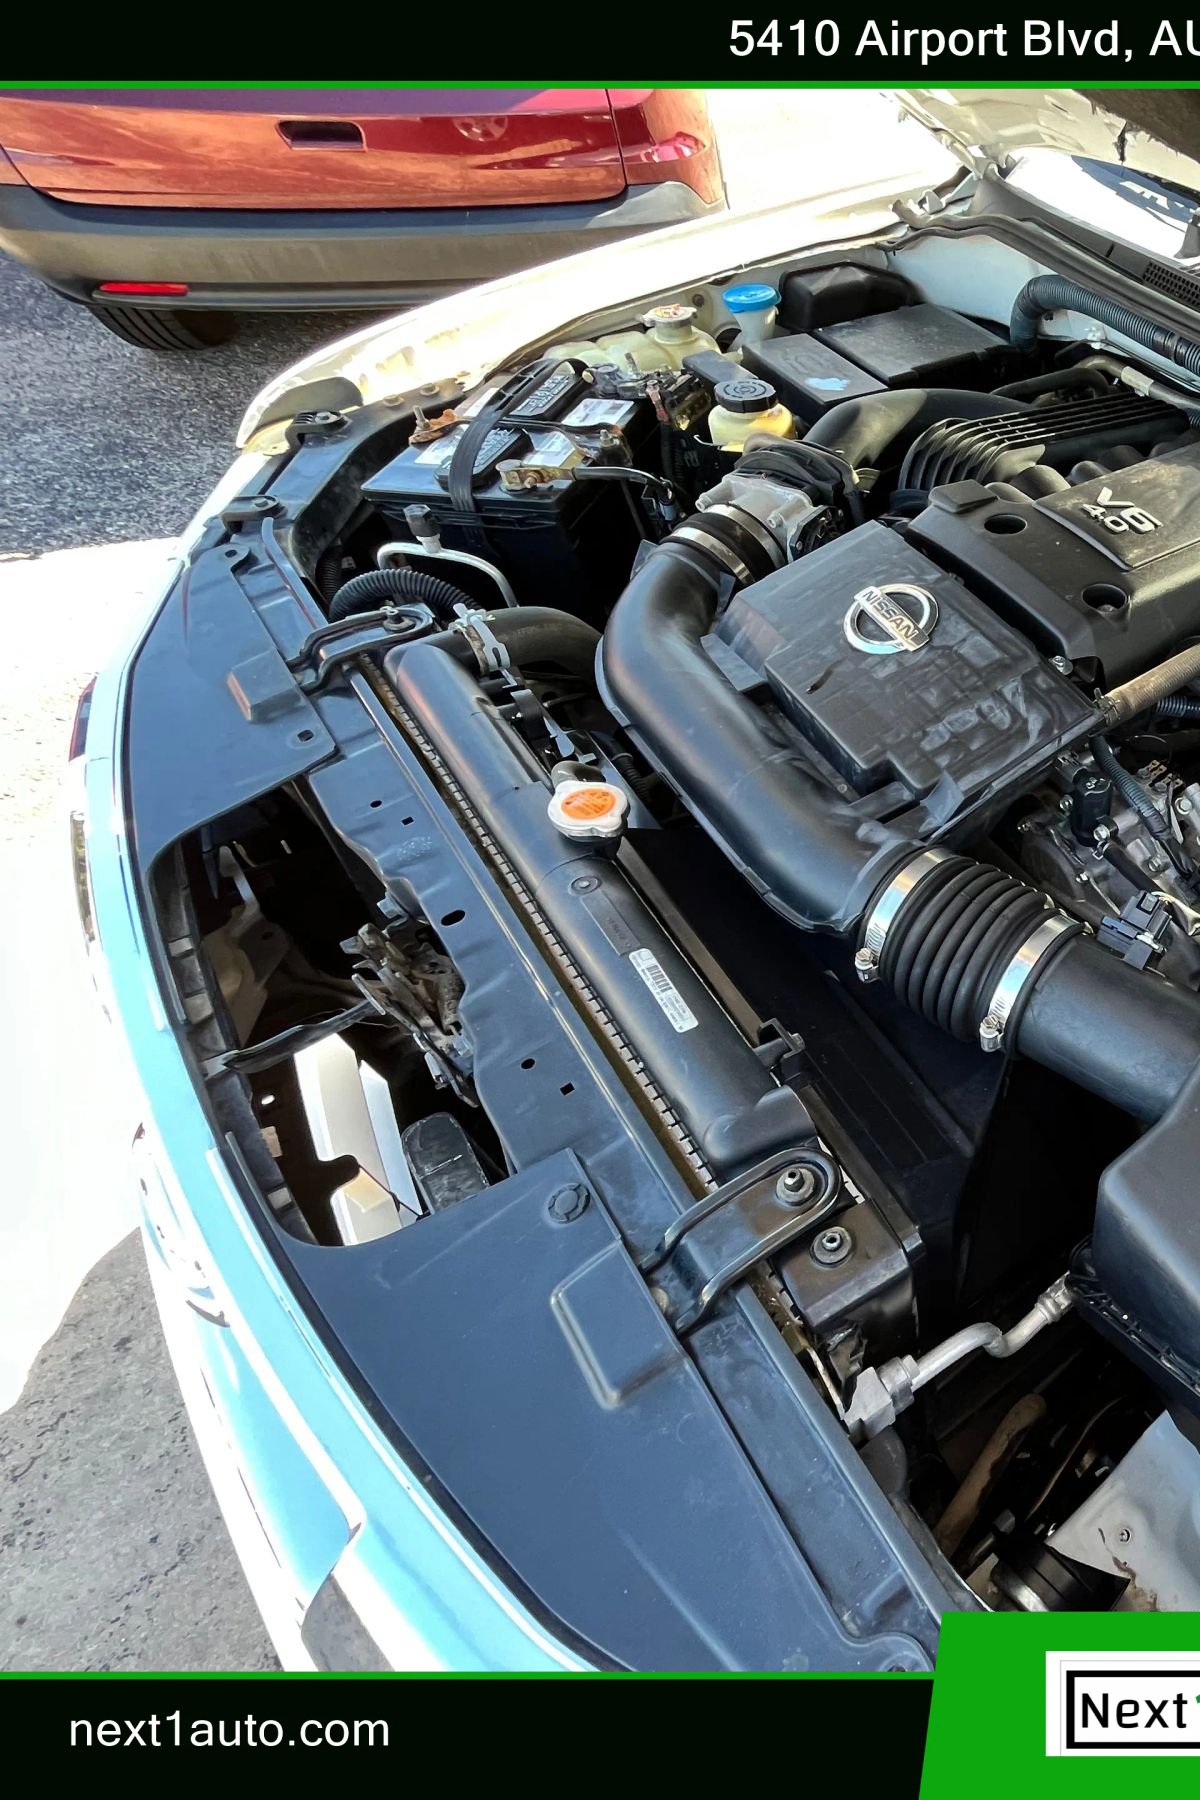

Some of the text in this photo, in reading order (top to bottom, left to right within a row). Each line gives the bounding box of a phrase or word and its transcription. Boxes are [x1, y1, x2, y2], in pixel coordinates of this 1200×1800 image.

[1083, 503, 1129, 533] 4.0
[1097, 486, 1164, 533] V6
[862, 590, 917, 639] NISSAN
